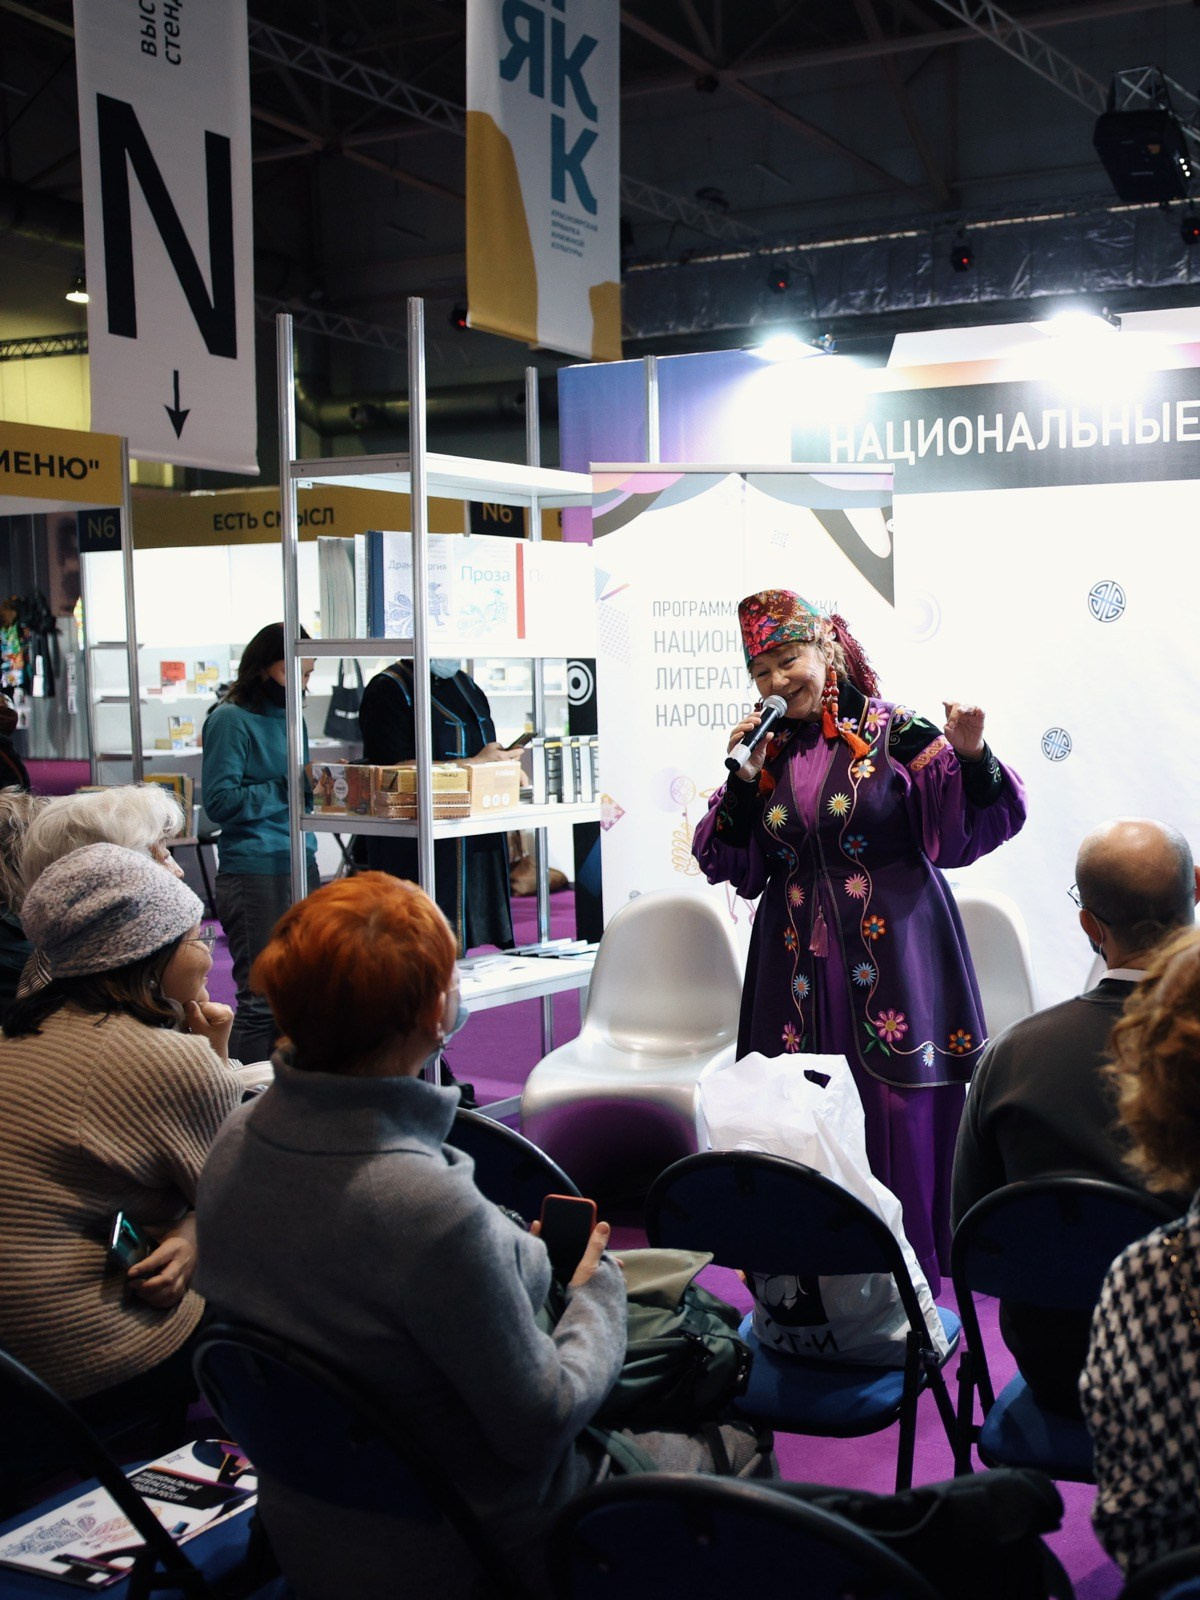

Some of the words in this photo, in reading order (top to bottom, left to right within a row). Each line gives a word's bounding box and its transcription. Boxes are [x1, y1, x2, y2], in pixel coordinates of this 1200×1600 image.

[96, 92, 238, 361] N
[87, 515, 116, 539] N6
[213, 512, 259, 532] ЕСТЬ
[263, 507, 335, 529] СЫСЛ
[388, 559, 447, 572] Драмргия
[461, 565, 511, 584] Проза
